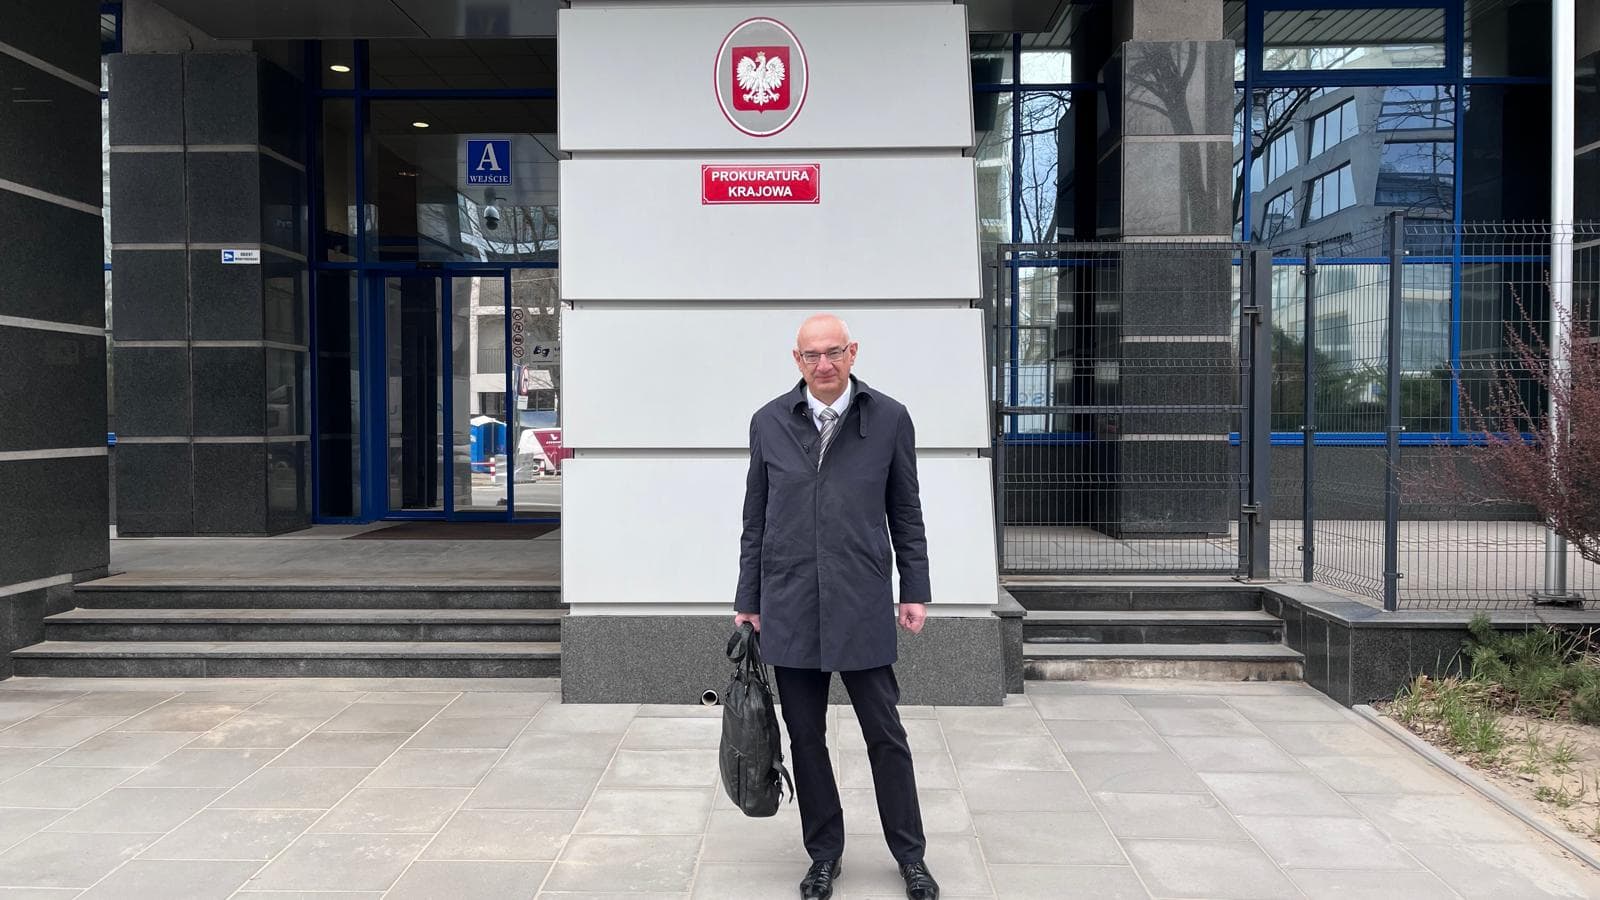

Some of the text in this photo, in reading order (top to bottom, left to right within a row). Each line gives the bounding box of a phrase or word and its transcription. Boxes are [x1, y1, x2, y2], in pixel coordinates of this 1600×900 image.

[476, 143, 502, 171] A
[470, 174, 509, 183] WEJŚCIE
[711, 171, 810, 181] PROKURATURA
[728, 186, 793, 197] KRAJOWA
